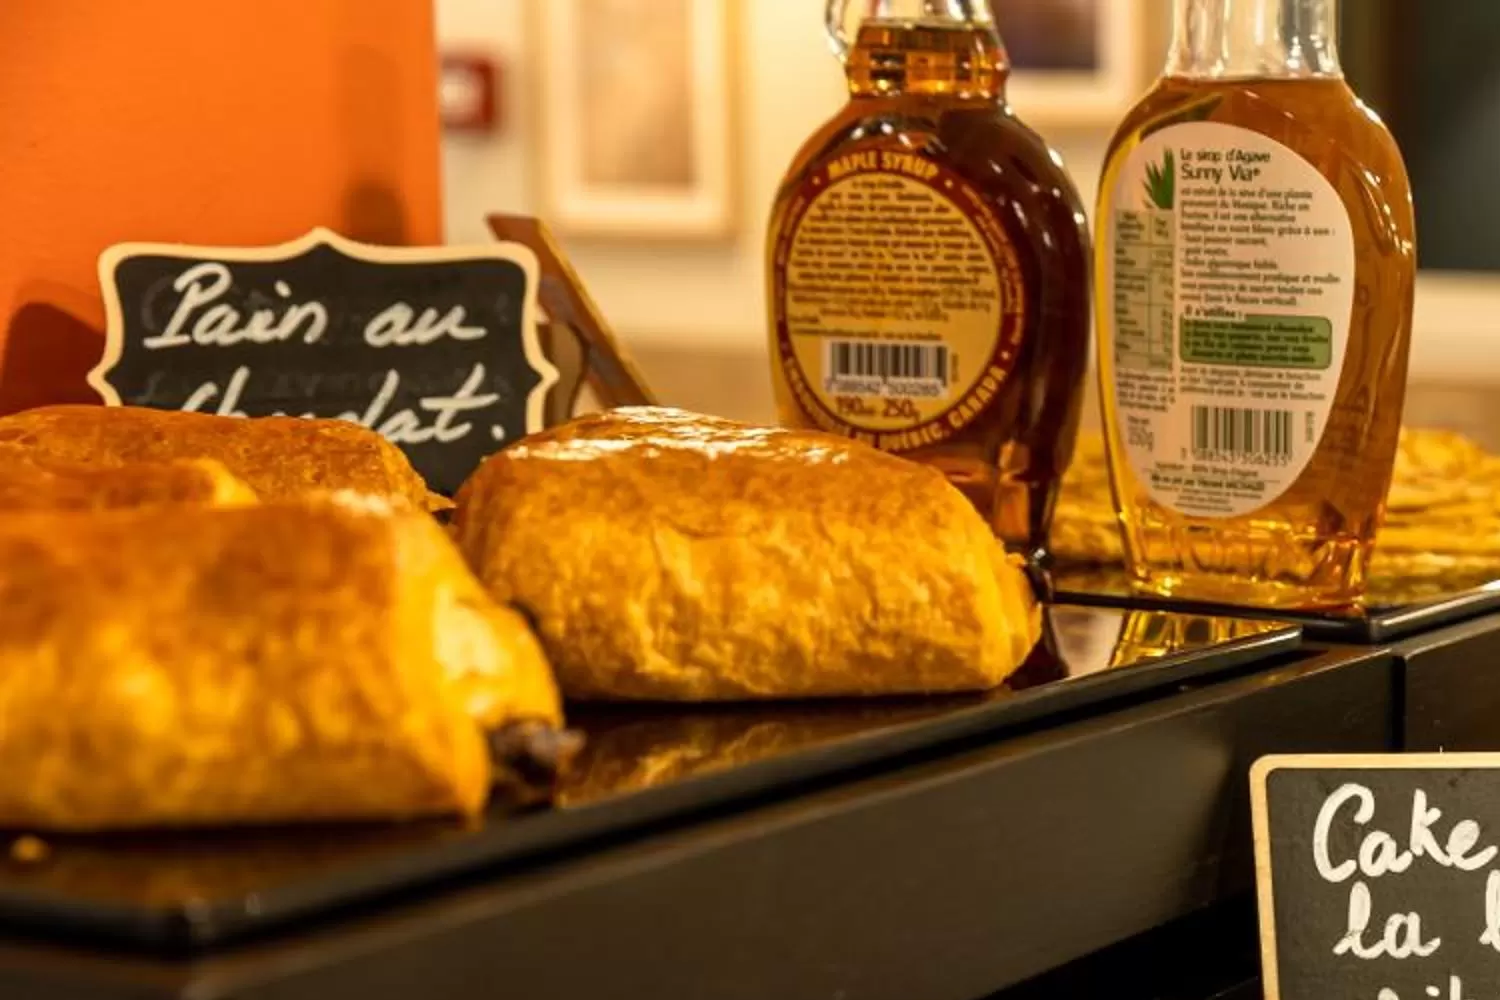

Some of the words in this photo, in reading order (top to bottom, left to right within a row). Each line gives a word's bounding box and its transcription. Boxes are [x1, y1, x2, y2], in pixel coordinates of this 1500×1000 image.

[827, 150, 877, 178] MAPLE
[882, 152, 940, 179] SYRUP
[1180, 148, 1192, 160] Le
[1181, 163, 1223, 184] Sunny
[143, 262, 329, 350] Pain
[364, 300, 487, 347] au
[947, 365, 1007, 430] CANADA
[1313, 782, 1498, 884] Cake
[1332, 880, 1441, 960] la
